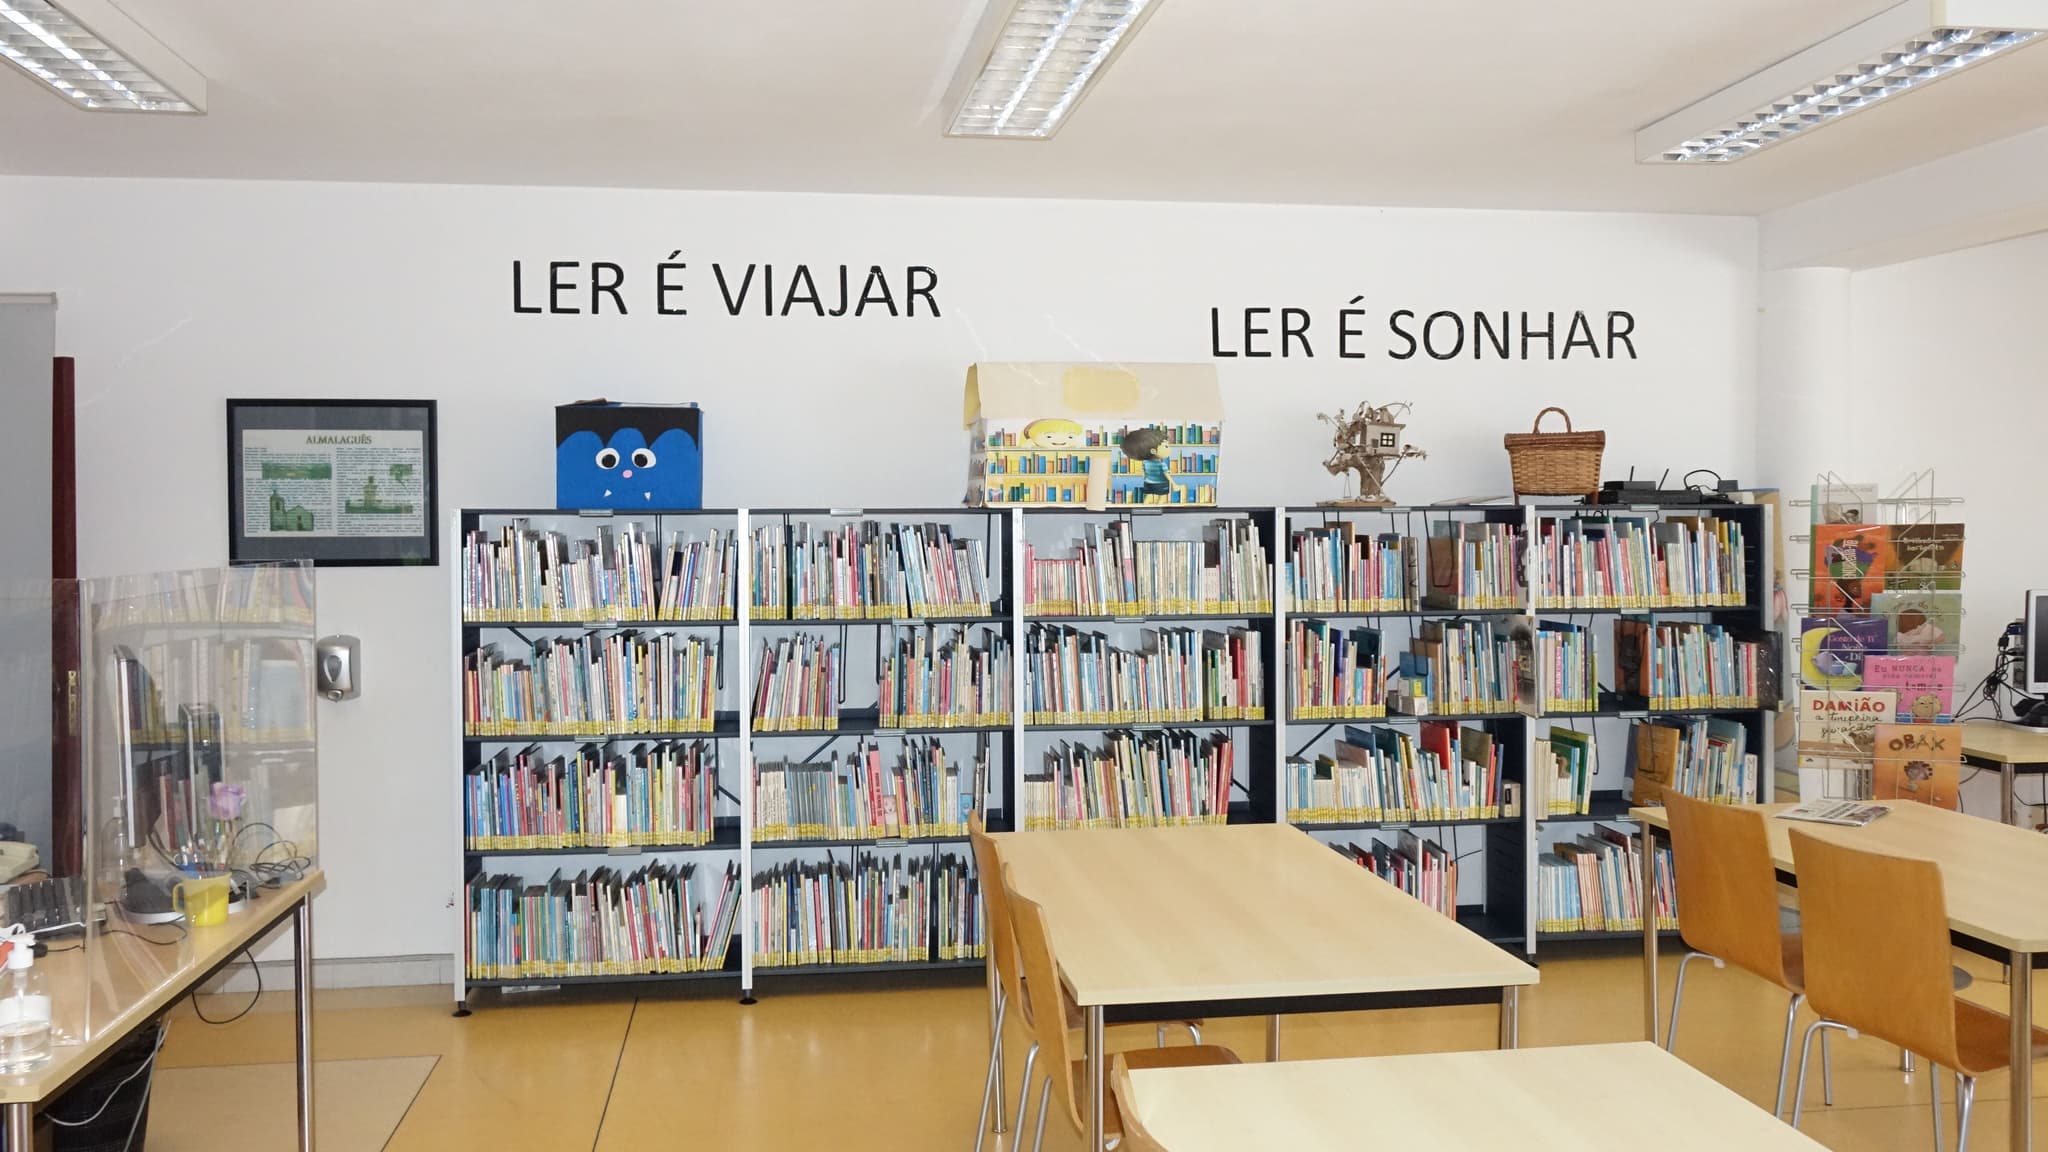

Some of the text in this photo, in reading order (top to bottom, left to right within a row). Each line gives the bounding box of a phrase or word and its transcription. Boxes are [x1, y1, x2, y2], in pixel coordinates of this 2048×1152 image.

[513, 249, 941, 317] LER É VIAJAR
[1211, 295, 1638, 360] LER É SONHAR
[306, 433, 373, 445] ALMALAGUÊS
[1874, 665, 1887, 673] Eu
[1892, 665, 1925, 673] NUNCA
